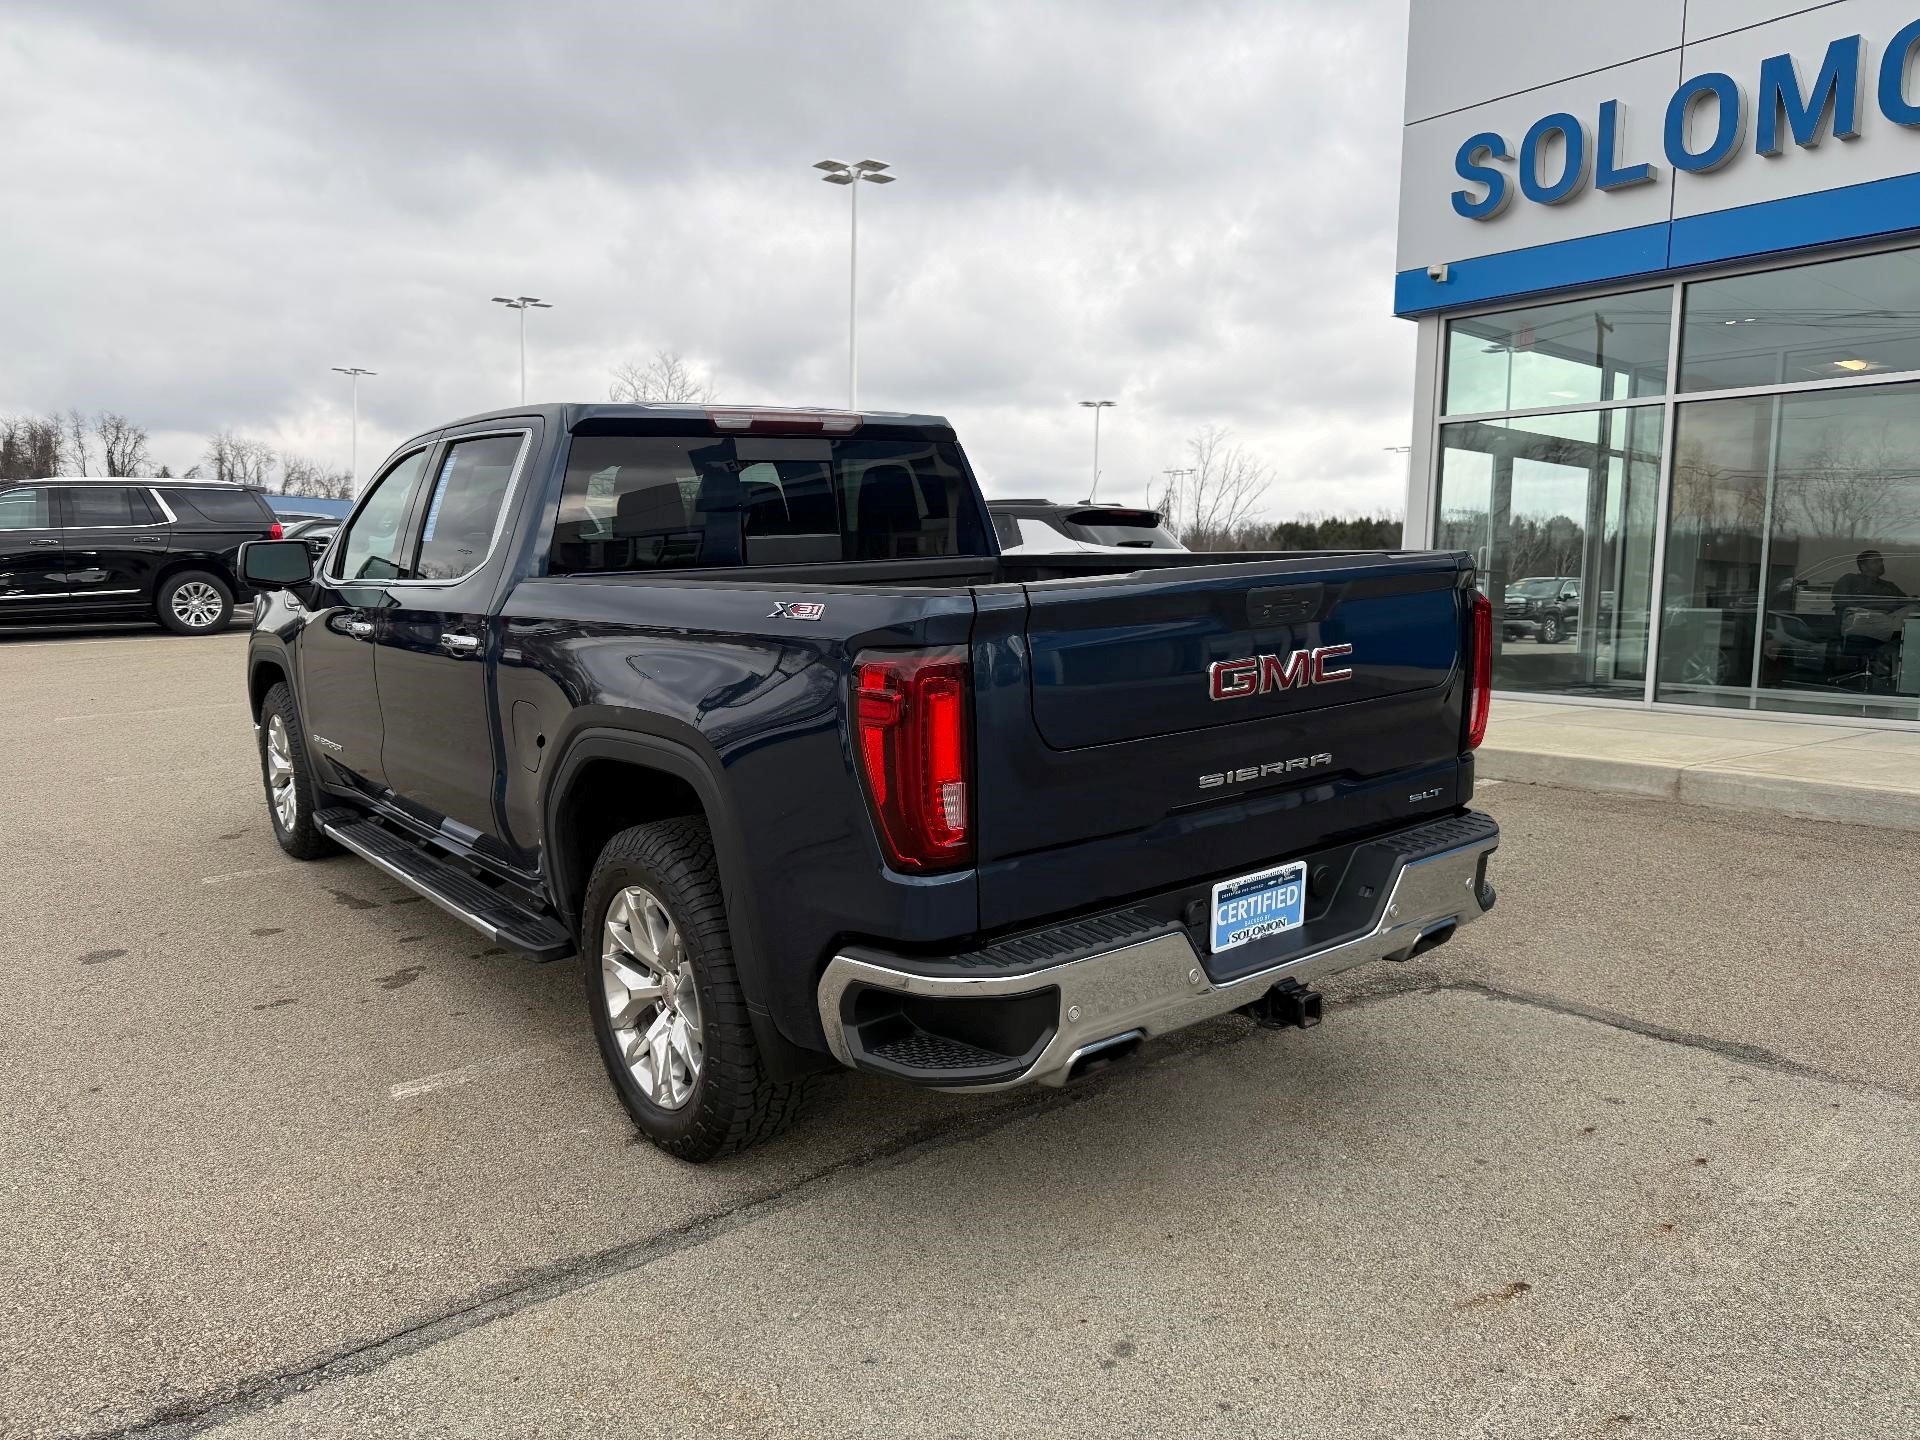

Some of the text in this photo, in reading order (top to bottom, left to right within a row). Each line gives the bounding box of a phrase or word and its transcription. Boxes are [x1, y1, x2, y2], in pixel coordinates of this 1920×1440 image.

[1209, 643, 1352, 701] GMC
[1199, 753, 1332, 789] SIERRA
[1409, 787, 1444, 803] SLT
[1217, 885, 1299, 926] CERTIFIED
[1231, 918, 1287, 943] SOLOMON
